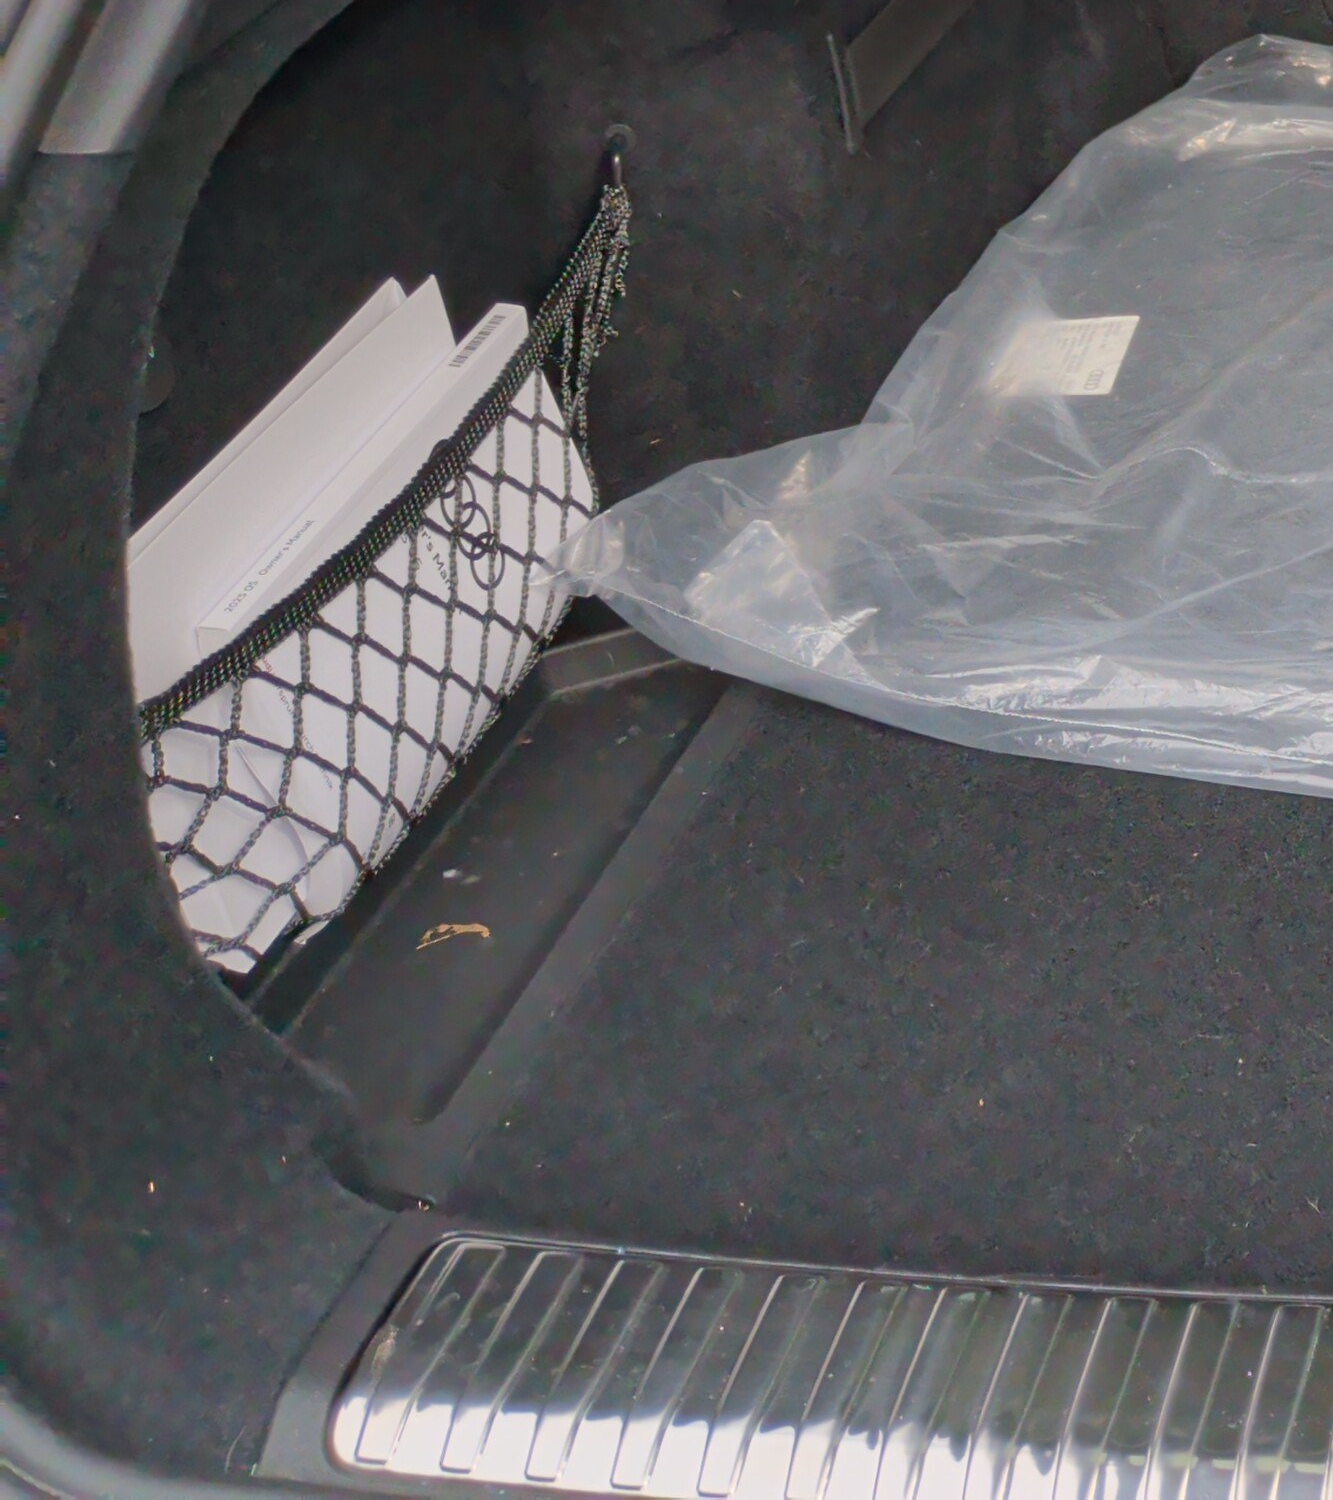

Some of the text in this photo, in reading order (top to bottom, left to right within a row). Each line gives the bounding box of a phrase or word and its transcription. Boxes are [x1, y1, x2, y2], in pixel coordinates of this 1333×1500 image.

[223, 592, 248, 613] 2025
[258, 547, 290, 576] Owner's
[285, 519, 315, 546] Manual
